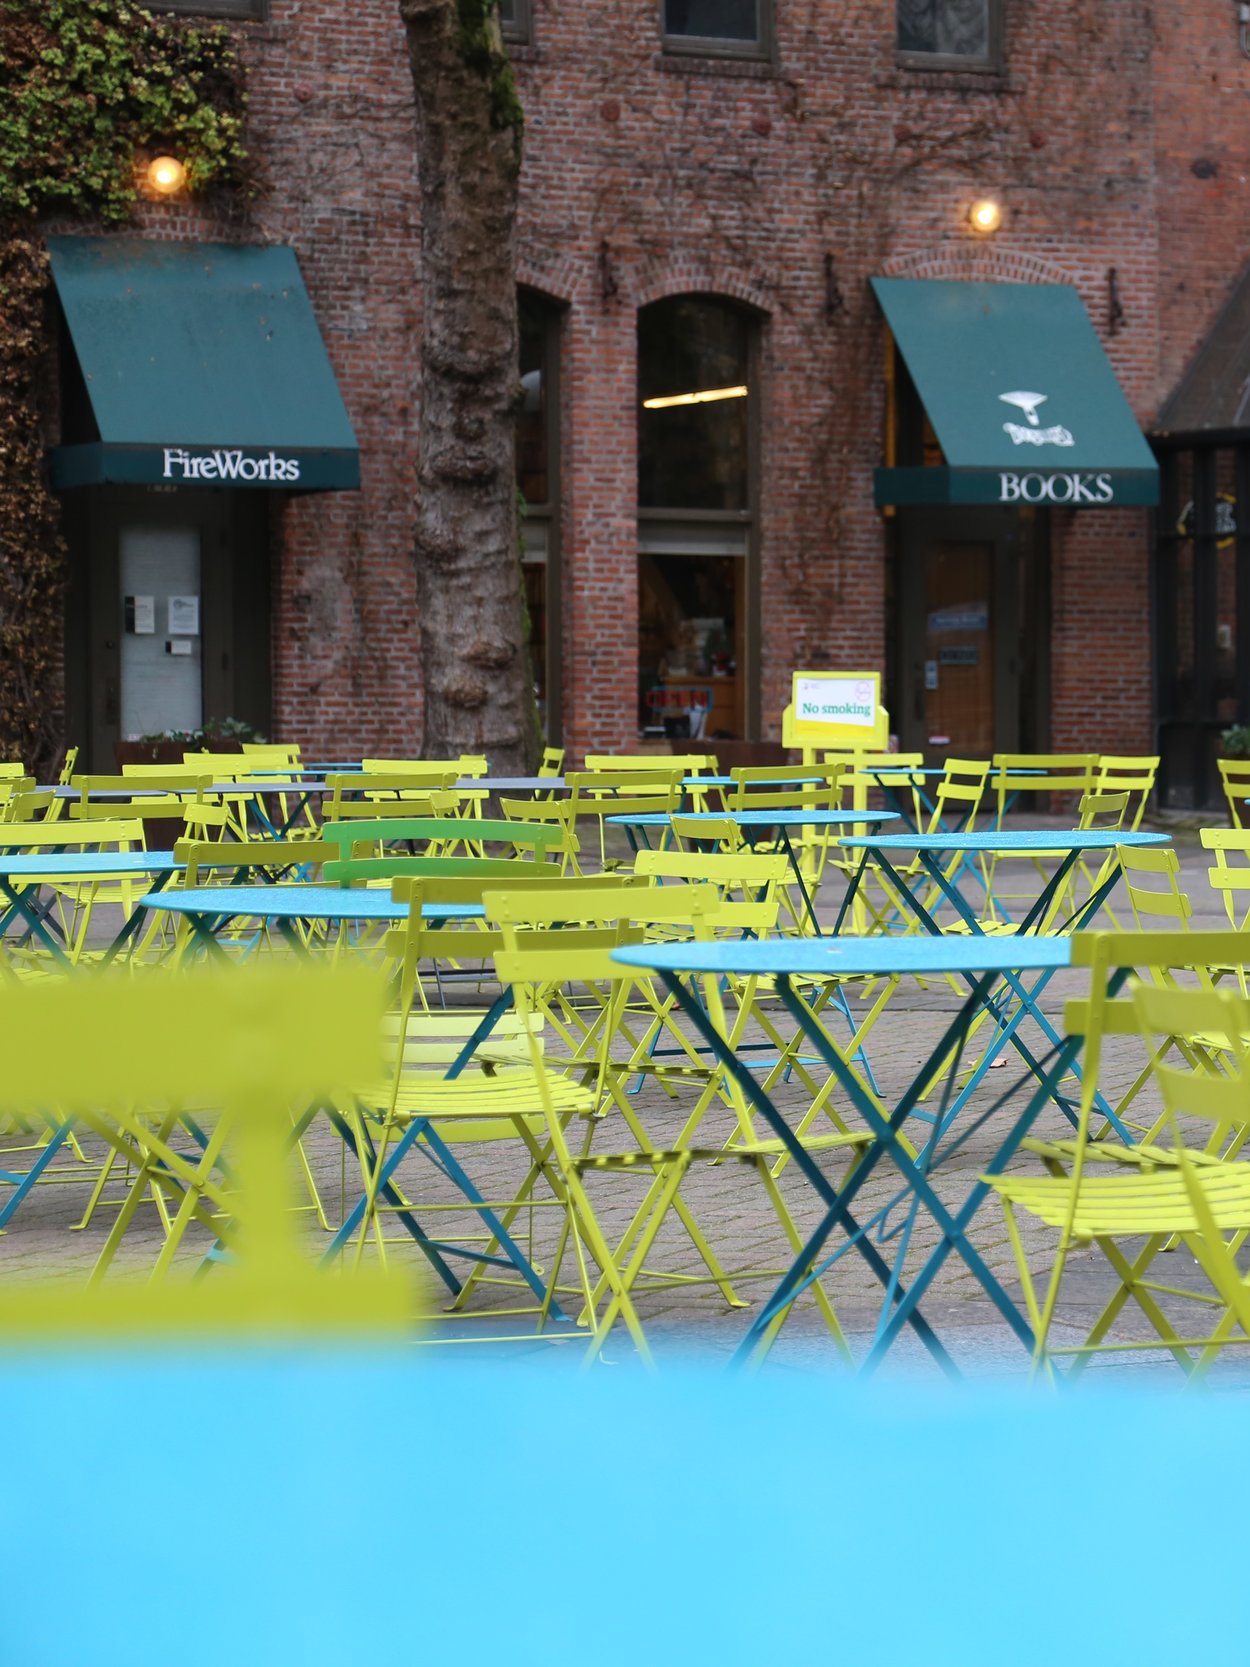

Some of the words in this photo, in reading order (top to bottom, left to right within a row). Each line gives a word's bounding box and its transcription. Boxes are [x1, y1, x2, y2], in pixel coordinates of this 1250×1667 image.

[162, 448, 300, 481] FireWorks
[998, 472, 1114, 503] BOOKS
[802, 702, 819, 714] No
[822, 703, 871, 717] smoking
